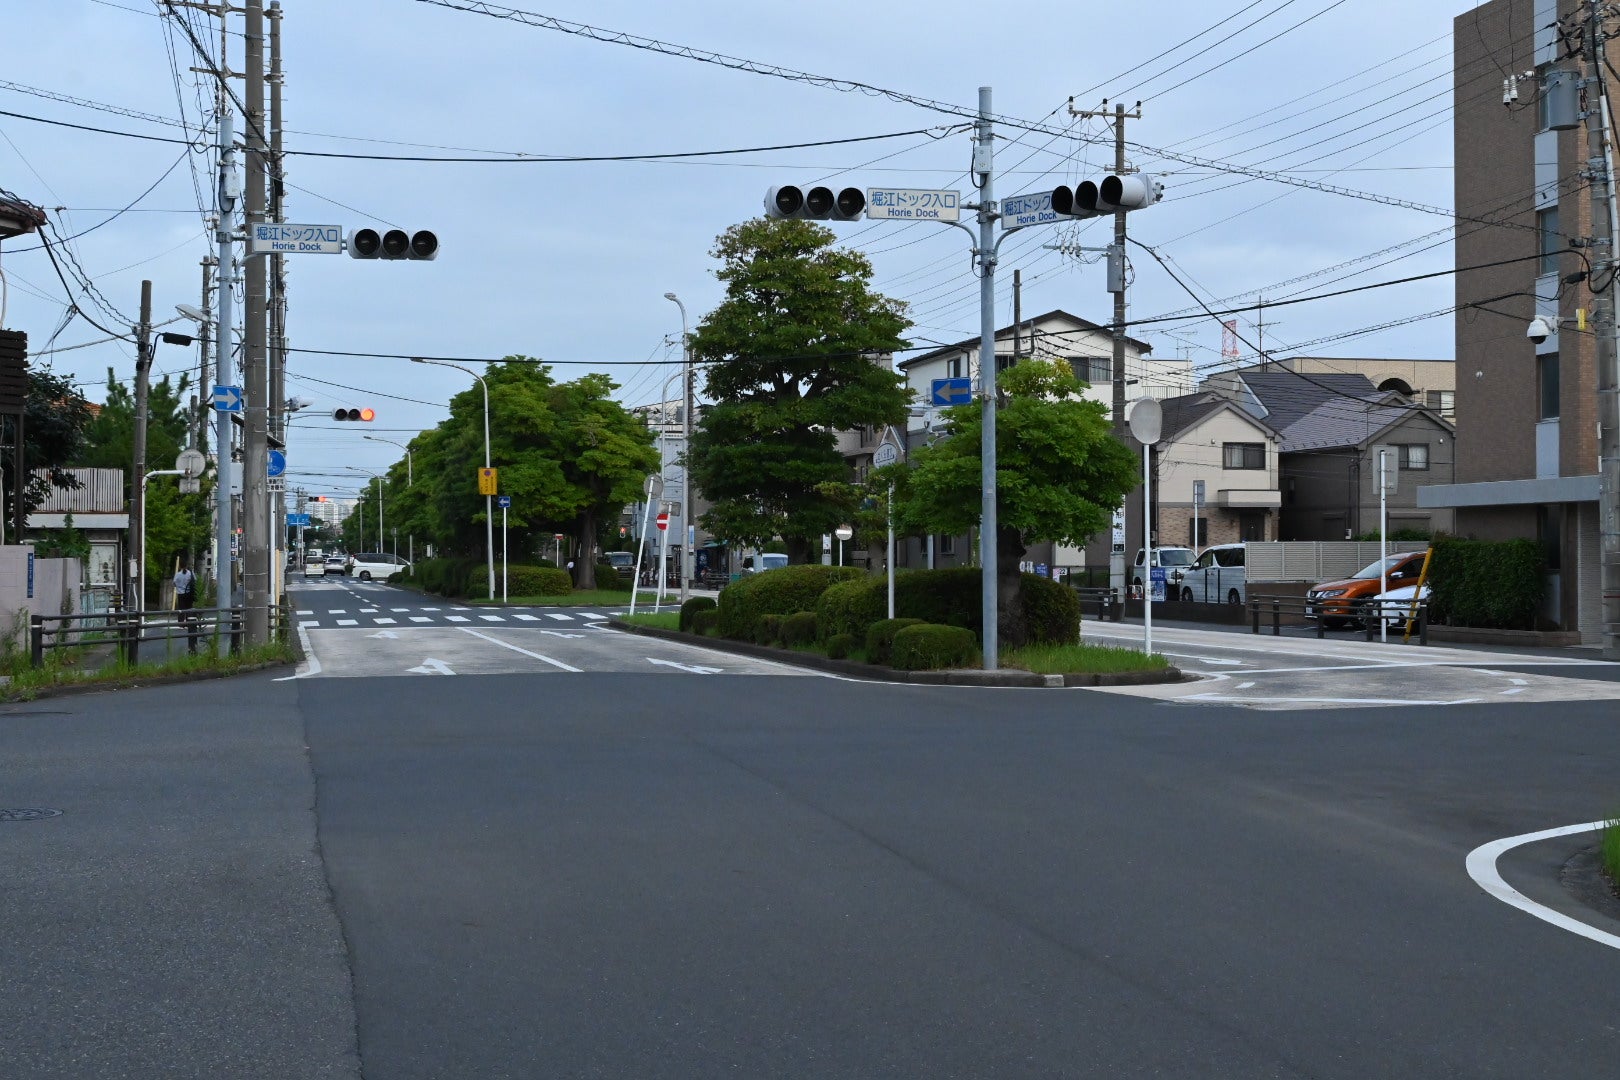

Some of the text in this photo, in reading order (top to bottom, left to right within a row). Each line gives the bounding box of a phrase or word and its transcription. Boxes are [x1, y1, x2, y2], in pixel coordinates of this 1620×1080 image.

[872, 191, 956, 208] 堀江ドック入口
[1004, 195, 1052, 216] 堀江ドック
[888, 208, 939, 218] Horie Dock
[1016, 210, 1058, 225] Horie Dock
[256, 226, 338, 242] 堀江ドック入口
[272, 241, 322, 251] Horie Dock
